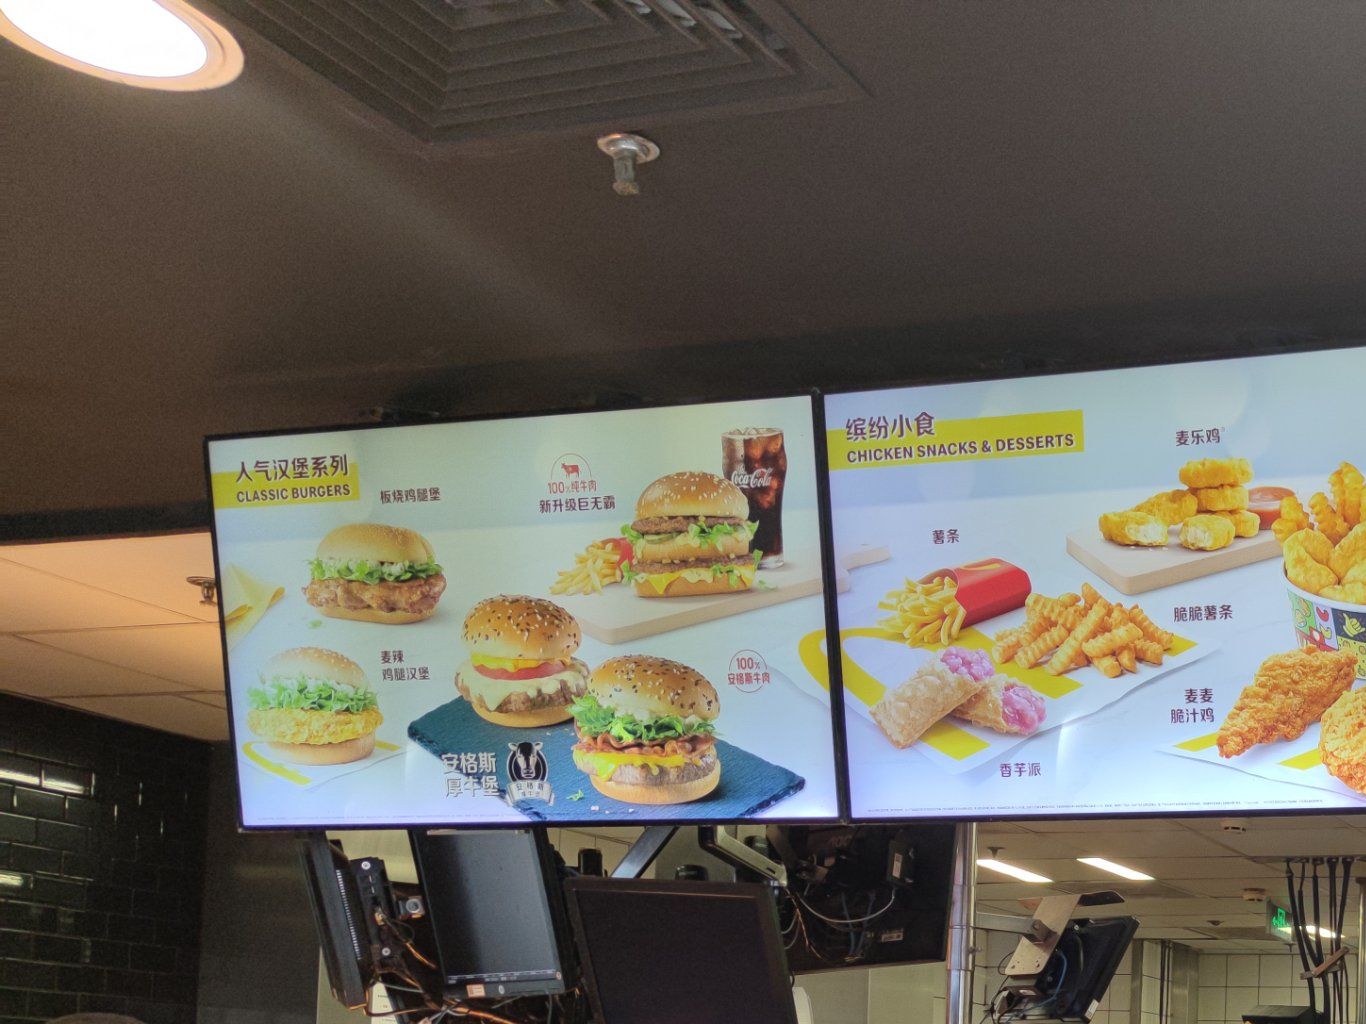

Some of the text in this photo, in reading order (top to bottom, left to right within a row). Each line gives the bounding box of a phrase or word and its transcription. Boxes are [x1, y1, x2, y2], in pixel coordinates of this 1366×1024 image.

[846, 411, 935, 441] 缤纷小食
[1175, 428, 1221, 447] 麦乐鸡
[847, 433, 1074, 463] CHICKEN SNACKS & DESSERTS
[236, 454, 348, 483] 人气汉堡系列
[236, 484, 350, 503] CLASSIC BURGERS
[380, 487, 441, 505] 板烧鸡腿堡
[539, 495, 616, 513] 新升级巨无霸
[932, 529, 960, 545] 薯条
[1173, 604, 1233, 622] 脆脆薯条
[380, 650, 404, 664] 麦辣
[381, 667, 431, 682] 鸡腿汉堡
[1184, 688, 1214, 704] 麦麦
[1170, 706, 1215, 724] 脆汁鸡
[441, 751, 497, 774] 安格斯
[999, 762, 1041, 778] 香芋派
[445, 775, 501, 798] 厚牛堡
